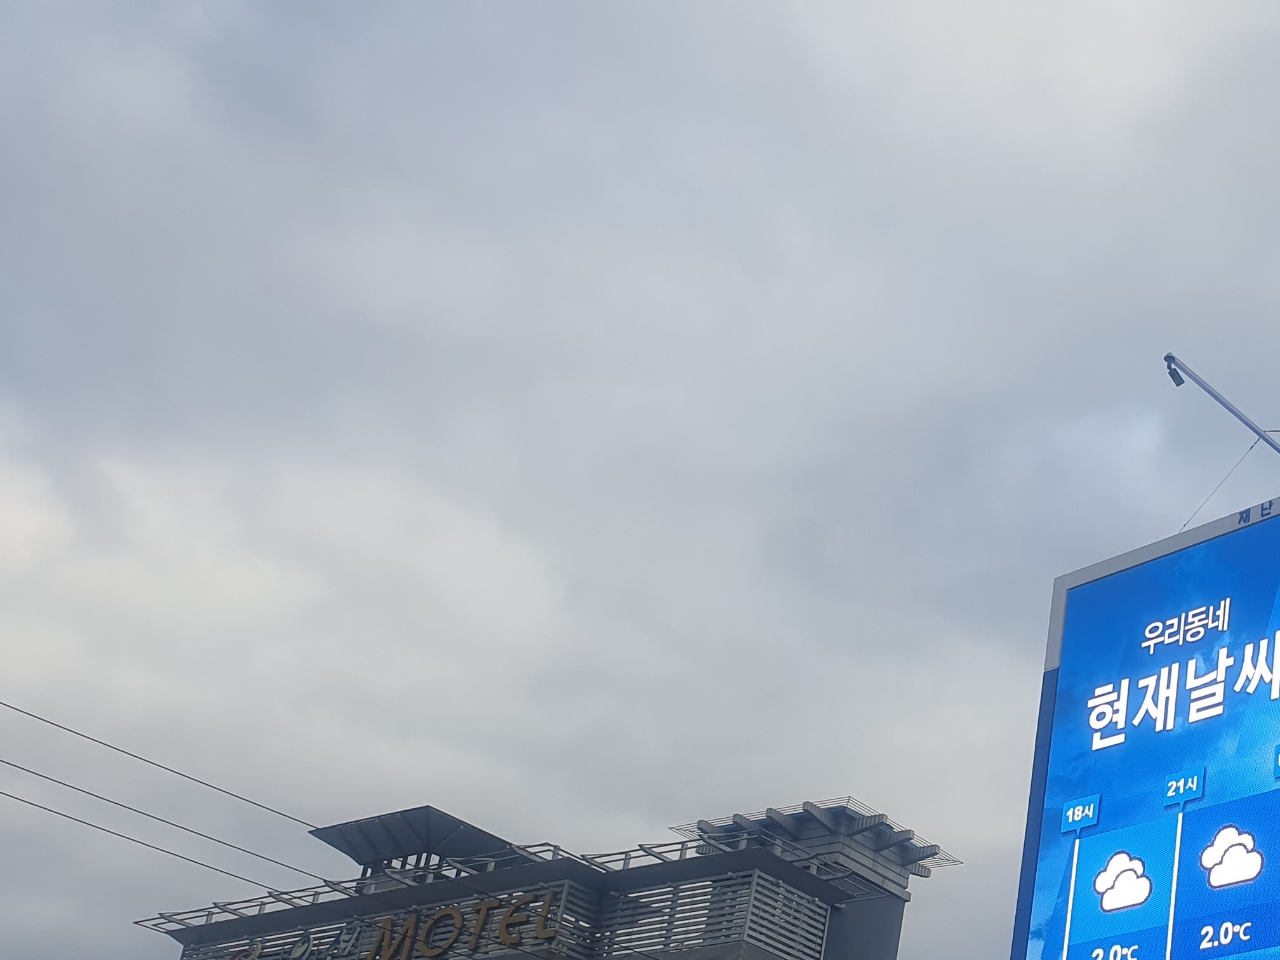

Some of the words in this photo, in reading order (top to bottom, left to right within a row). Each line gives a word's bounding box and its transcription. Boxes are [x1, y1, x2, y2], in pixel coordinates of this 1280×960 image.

[1141, 597, 1231, 655] 우리동네
[1166, 775, 1199, 797] 21시
[1066, 803, 1095, 823] 18시
